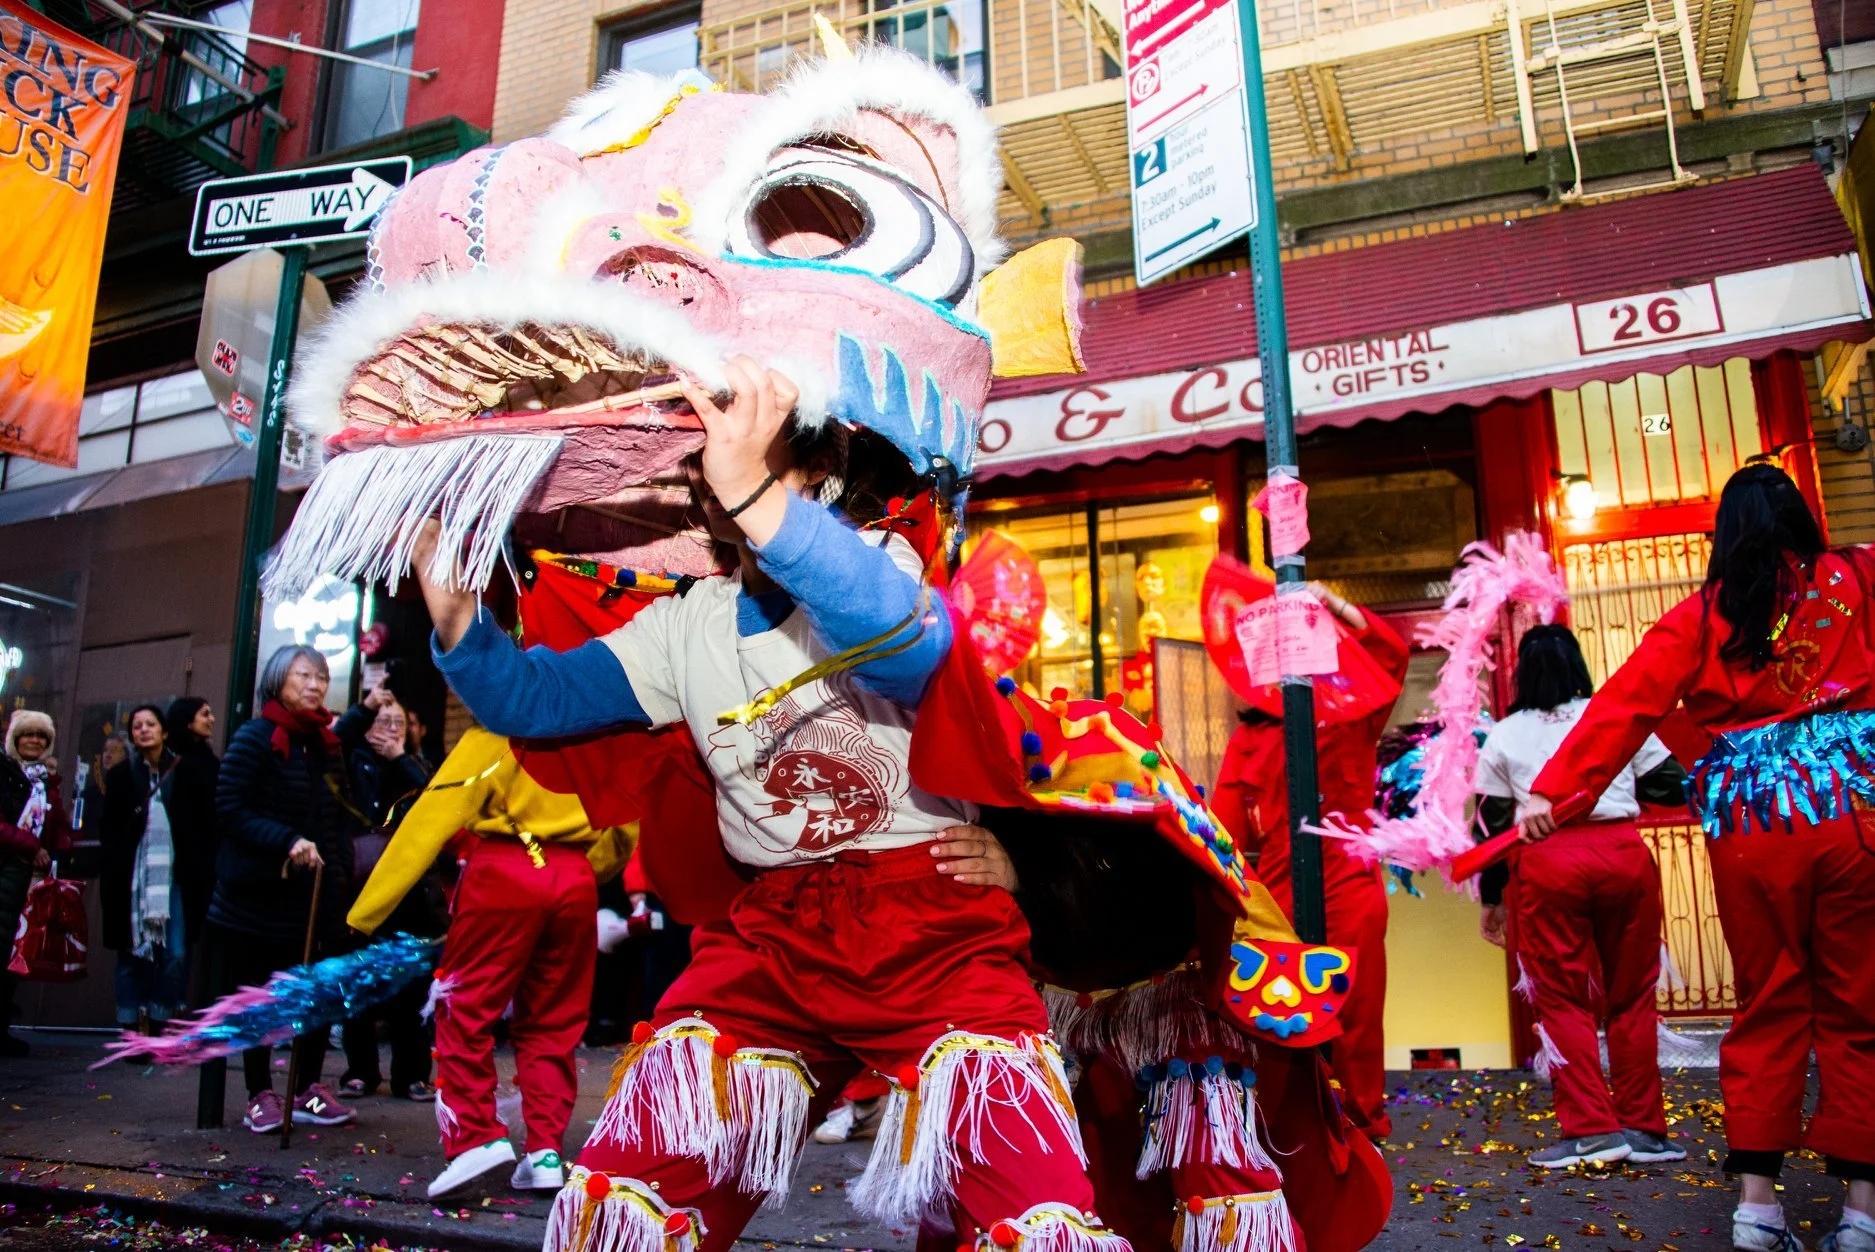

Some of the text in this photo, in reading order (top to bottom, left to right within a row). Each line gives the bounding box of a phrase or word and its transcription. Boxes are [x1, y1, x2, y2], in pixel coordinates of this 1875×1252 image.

[0, 58, 87, 143] CK
[1171, 128, 1208, 155] metered
[1141, 142, 1160, 182] 2
[1188, 165, 1215, 187] 10pm
[215, 185, 377, 227] ONE WAY
[1142, 181, 1217, 231] Except Sunday
[1610, 297, 1681, 341] 26
[1302, 329, 1450, 373] ORIENTAL
[1332, 360, 1430, 396] GIFTS
[1055, 387, 1126, 441] &
[1644, 416, 1671, 433] 26
[1237, 600, 1320, 626] NO PARKING
[793, 758, 831, 789] 永
[809, 814, 856, 843] 和
